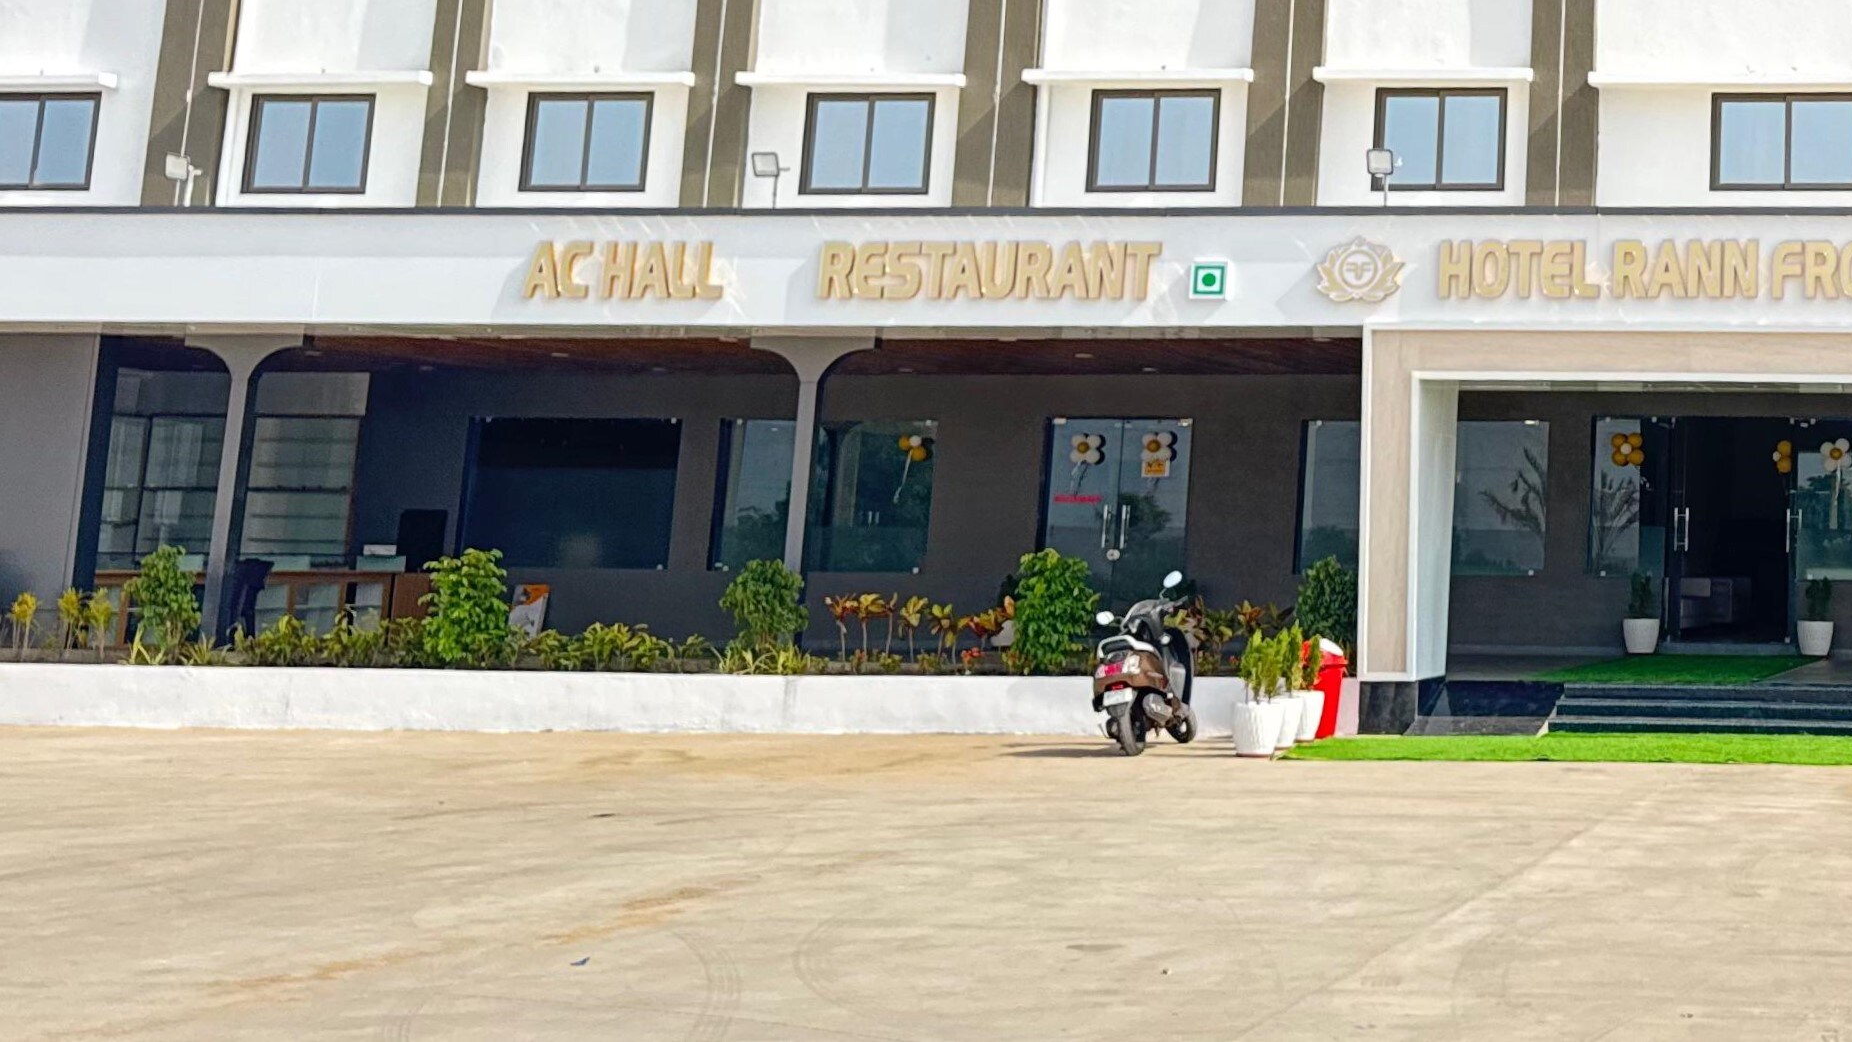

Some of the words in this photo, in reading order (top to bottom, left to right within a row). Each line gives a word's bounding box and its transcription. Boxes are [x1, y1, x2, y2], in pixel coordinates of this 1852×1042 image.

[522, 241, 595, 299] AC
[599, 241, 724, 299] HALL
[816, 241, 1162, 300] RESTAURANT
[1438, 240, 1600, 299] HOTEL
[1612, 239, 1759, 299] RANN
